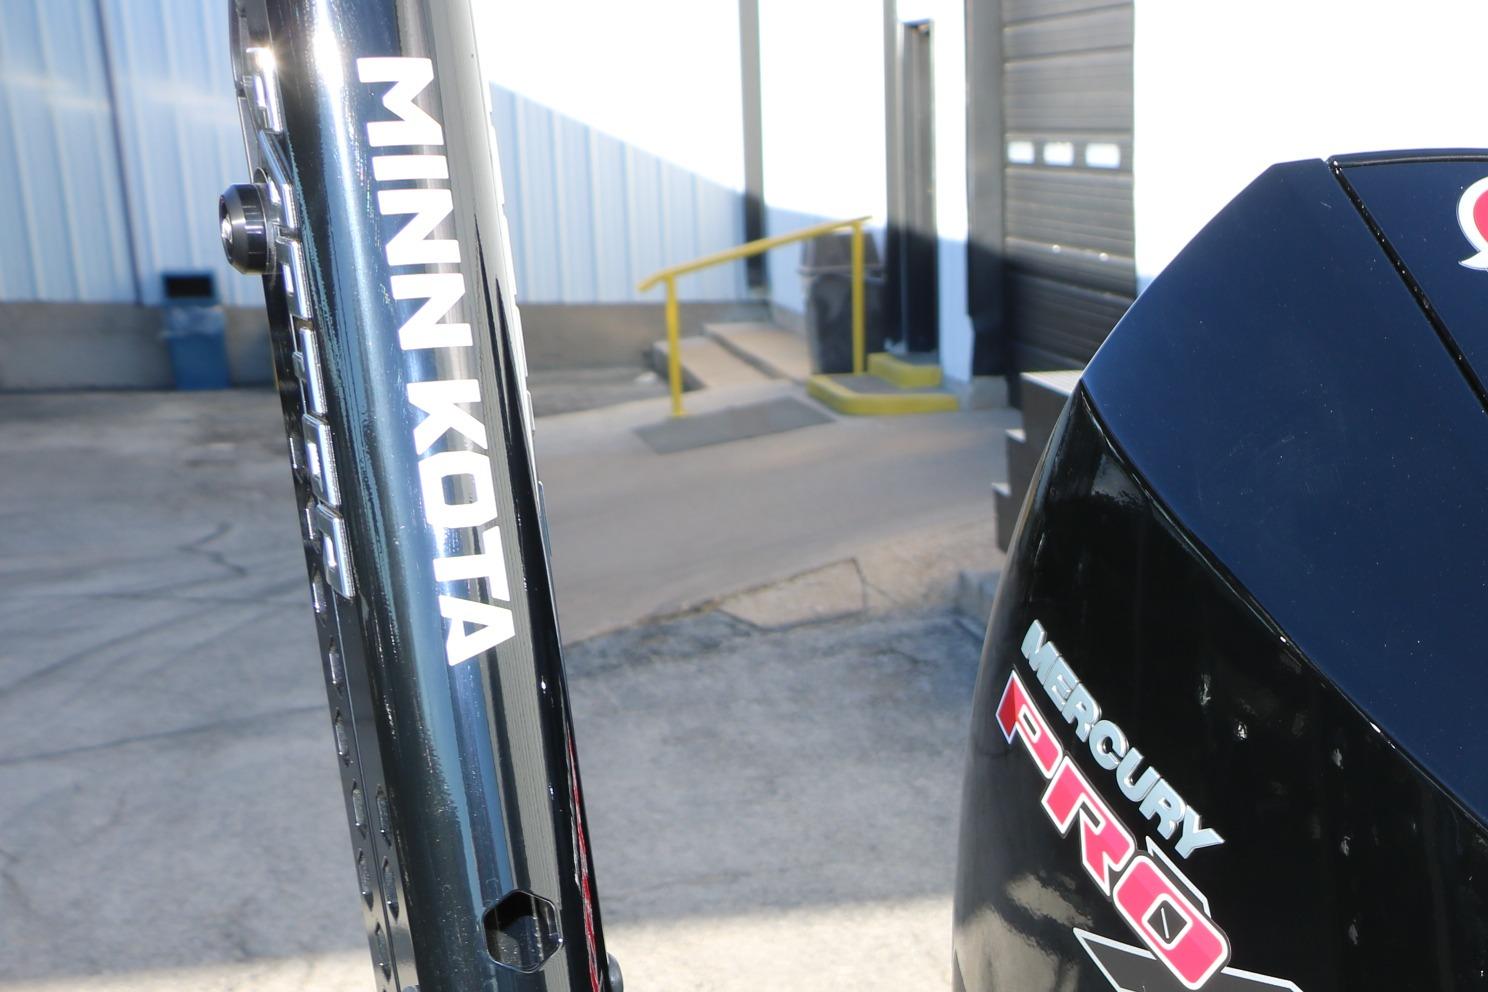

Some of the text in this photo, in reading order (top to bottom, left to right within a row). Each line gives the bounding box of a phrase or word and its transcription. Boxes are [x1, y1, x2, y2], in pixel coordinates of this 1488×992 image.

[357, 57, 515, 666] MINN KOTA
[996, 669, 1230, 990] PRO
[1021, 619, 1225, 859] MERCURY
